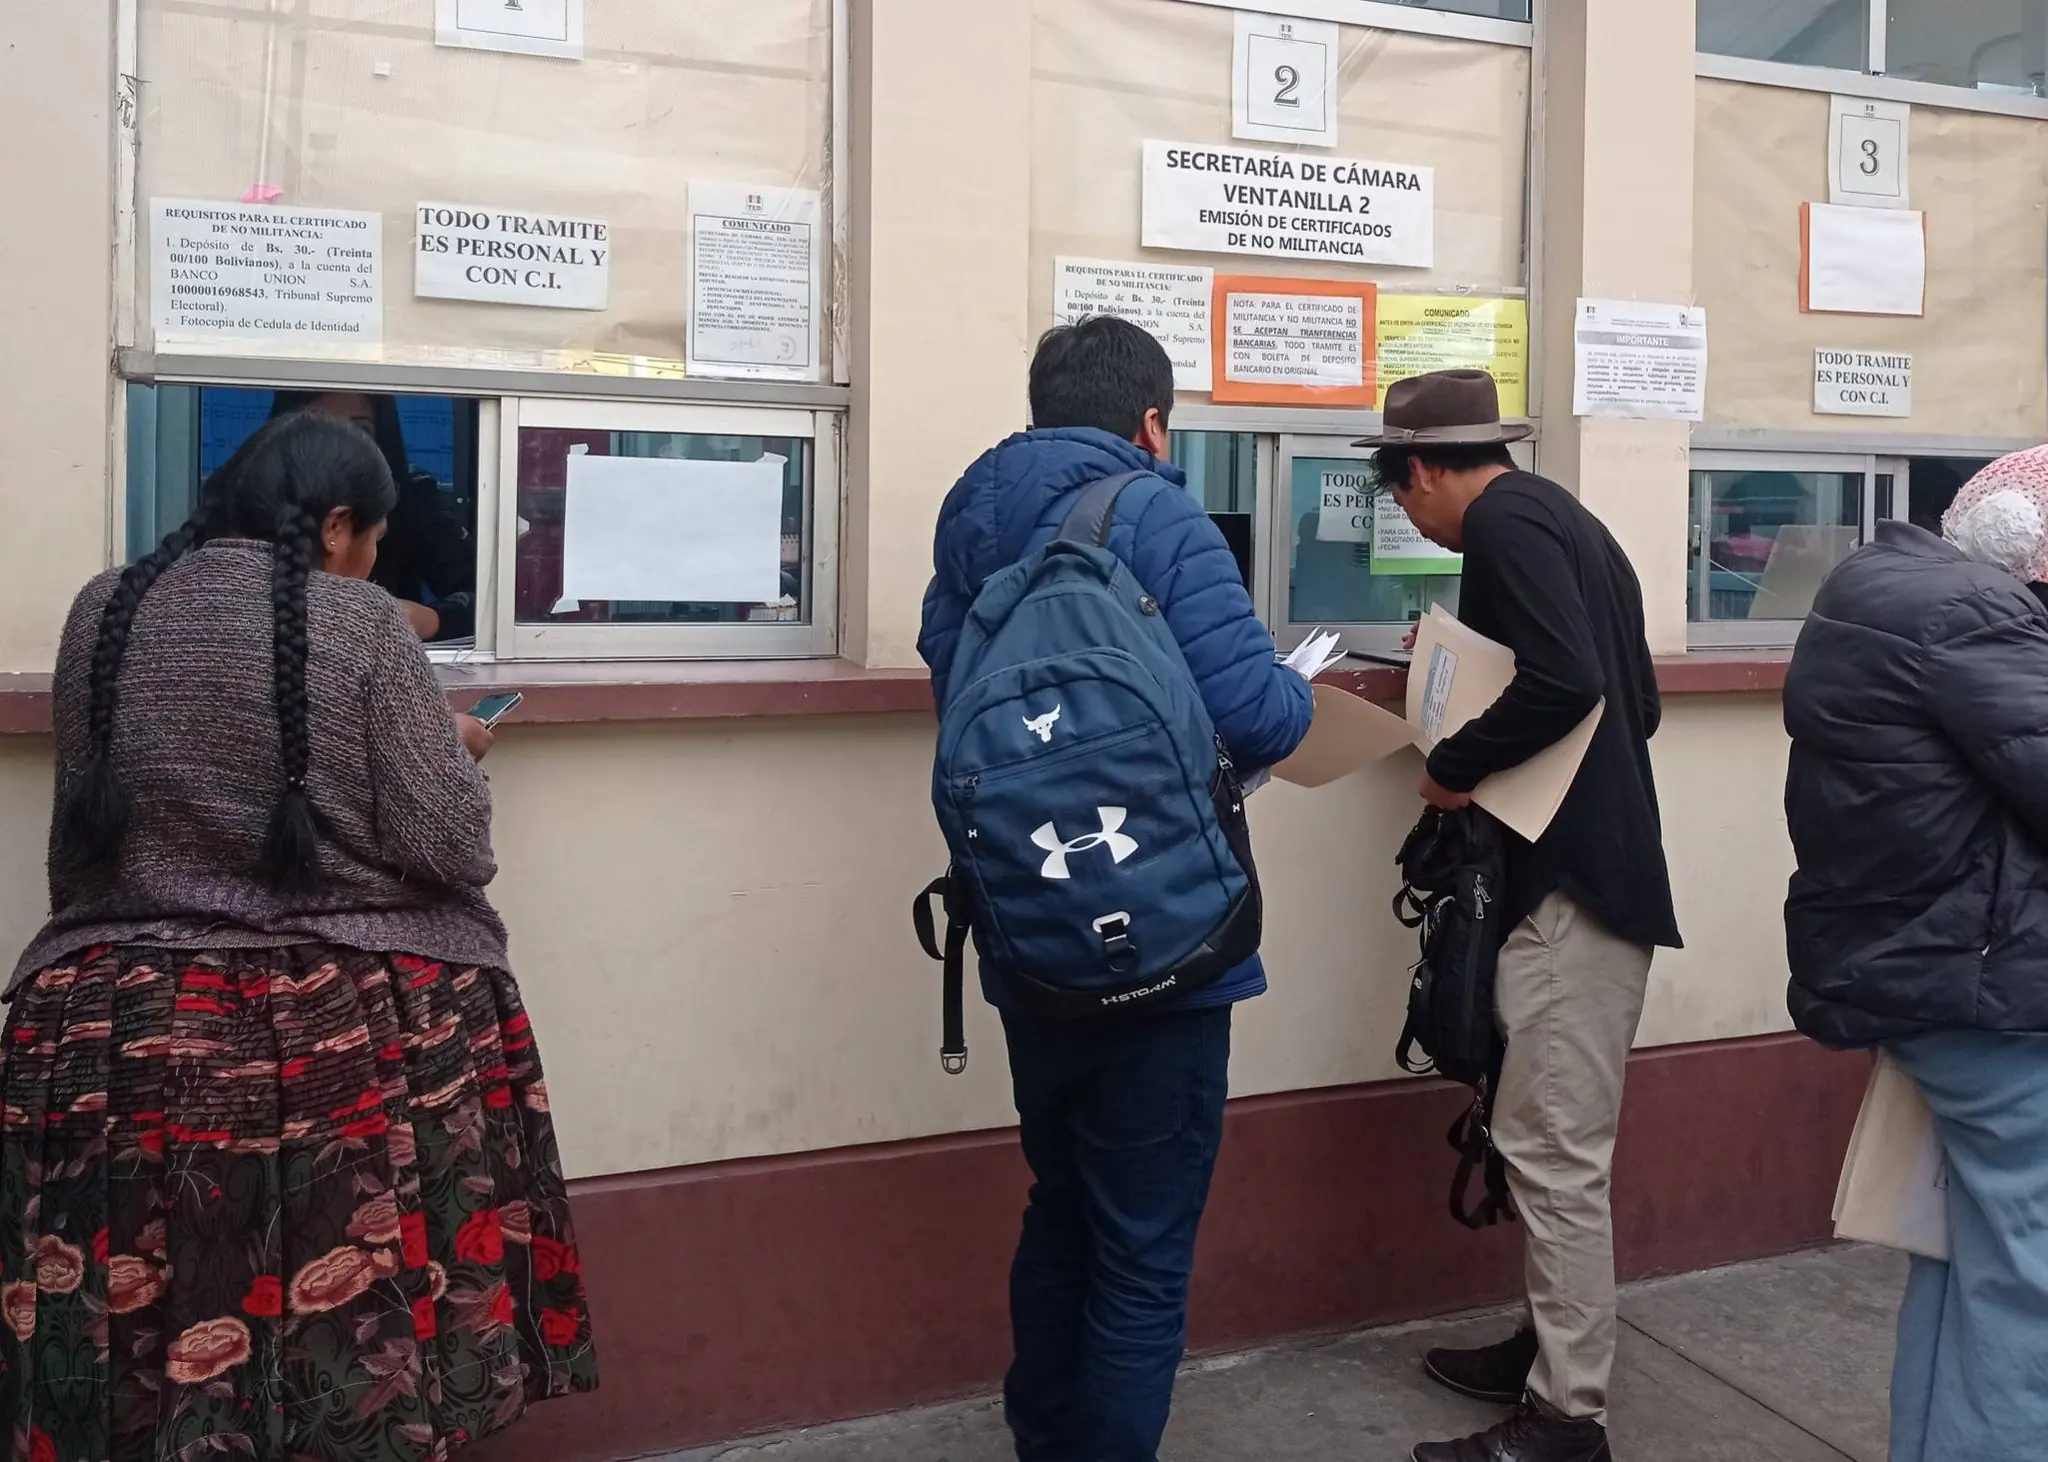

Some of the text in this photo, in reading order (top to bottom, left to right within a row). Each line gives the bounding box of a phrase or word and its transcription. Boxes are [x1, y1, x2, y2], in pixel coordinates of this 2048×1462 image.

[1274, 65, 1300, 108] 2
[1860, 139, 1880, 176] 3
[1166, 150, 1421, 192] SECRETARÍA DE CÁMARA
[1223, 183, 1371, 214] VENTANILLA 2
[165, 208, 367, 230] REQUISITOS PARA EL CERTIFICADO
[419, 207, 607, 241] TODO TRAMITE
[722, 220, 791, 233] COMUNICADO
[1199, 209, 1392, 238] EMISIÓN DE CERTIFICADOS
[212, 224, 323, 239] DE NO MILITANCIA:
[180, 238, 230, 251] Depósito
[241, 242, 254, 251] de
[266, 243, 283, 253] Bs.
[294, 245, 315, 255] 30.-
[327, 246, 372, 259] (Treinta
[420, 234, 607, 266] ES PERSONAL Y
[1227, 233, 1364, 256] DE NO MILITANCIA
[170, 253, 372, 274] 00/100 Bolivianos), a la cuenta del
[170, 269, 372, 288] BANCO UNION S.A.
[466, 266, 562, 289] CON C.I.
[1065, 265, 1113, 276] REQUISITOS
[1114, 269, 1135, 278] PARA
[1149, 272, 1203, 283] CERTIFICADO
[275, 289, 320, 301] Tribunal
[326, 292, 373, 305] Supremo
[1075, 290, 1108, 301] Depósito
[1115, 293, 1124, 301] de
[1132, 294, 1144, 303] Bs.
[1173, 296, 1205, 307] (Treinta
[171, 300, 227, 313] Electoral).
[1067, 302, 1094, 312] 00/100
[1155, 308, 1162, 316] la
[1166, 310, 1190, 318] cuenta
[1193, 310, 1205, 319] del
[1261, 302, 1281, 310] PARA
[1285, 303, 1293, 311] EL
[1298, 303, 1343, 313] CERTIFICADO
[1348, 305, 1356, 314] DE
[1424, 308, 1470, 318] COMUNICADO
[180, 316, 235, 329] Fotocopia
[238, 318, 251, 328] de
[254, 319, 292, 330] Cedula
[295, 320, 308, 331] de
[311, 320, 360, 333] Identidad
[1189, 323, 1204, 332] S.A.
[1233, 312, 1357, 327] MILITANCIA Y NO MILITANCIA NO
[1172, 335, 1205, 345] Supremo
[1233, 326, 1357, 339] SE ACEPTAN TRANFERENCIAS
[1616, 335, 1669, 346] IMPORTANTE
[1284, 340, 1305, 349] TODO
[1312, 342, 1342, 351] TRAMITE
[1349, 344, 1357, 352] ES
[1233, 351, 1356, 364] CON BOLETA DE DEPOSITO
[1816, 352, 1911, 370] TODO TRAMITE
[1233, 364, 1318, 376] BANCARIO EN ORIGINAL
[1817, 370, 1910, 387] ES PERSONAL Y
[1840, 389, 1889, 404] CON C.I.
[1323, 473, 1367, 488] TODO
[1323, 494, 1341, 508] ES
